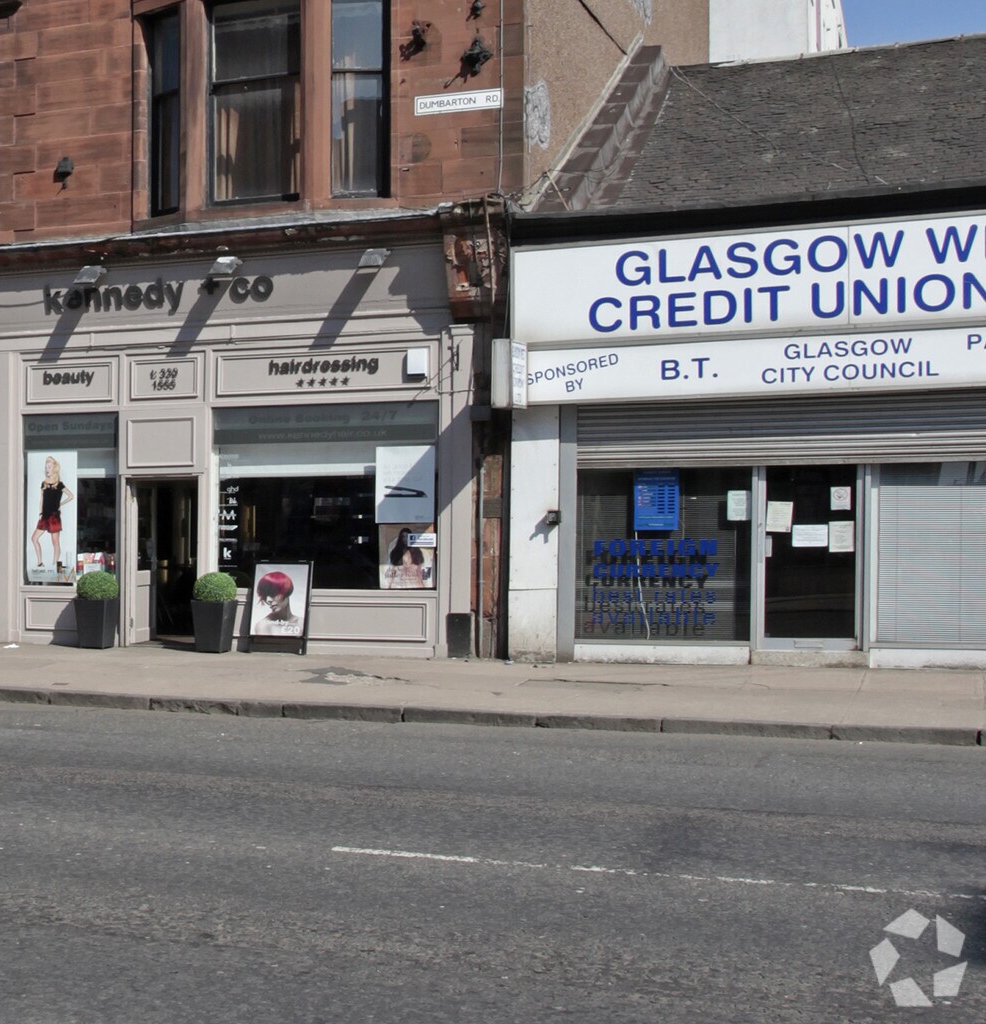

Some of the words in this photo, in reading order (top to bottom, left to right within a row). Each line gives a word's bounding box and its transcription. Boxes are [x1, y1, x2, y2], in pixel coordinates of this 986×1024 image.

[419, 97, 476, 109] DUMBARTON
[615, 229, 905, 286] GLASGOW
[925, 224, 986, 264] W
[43, 276, 185, 316] kennedy
[229, 275, 274, 304] co
[588, 285, 790, 333] CREDIT
[811, 272, 986, 319] UNION
[784, 337, 913, 360] GLASGOW
[268, 356, 379, 375] hairdressing
[527, 353, 619, 386] SPONSORED
[661, 357, 718, 380] B.T.
[761, 366, 815, 384] CITY
[823, 361, 939, 382] COUNCIL
[43, 370, 95, 387] beauty
[565, 378, 583, 392] BY
[360, 410, 398, 421] 24/7
[28, 422, 59, 432] Open
[62, 421, 113, 432] Sundays
[593, 538, 718, 556] FOREIGN
